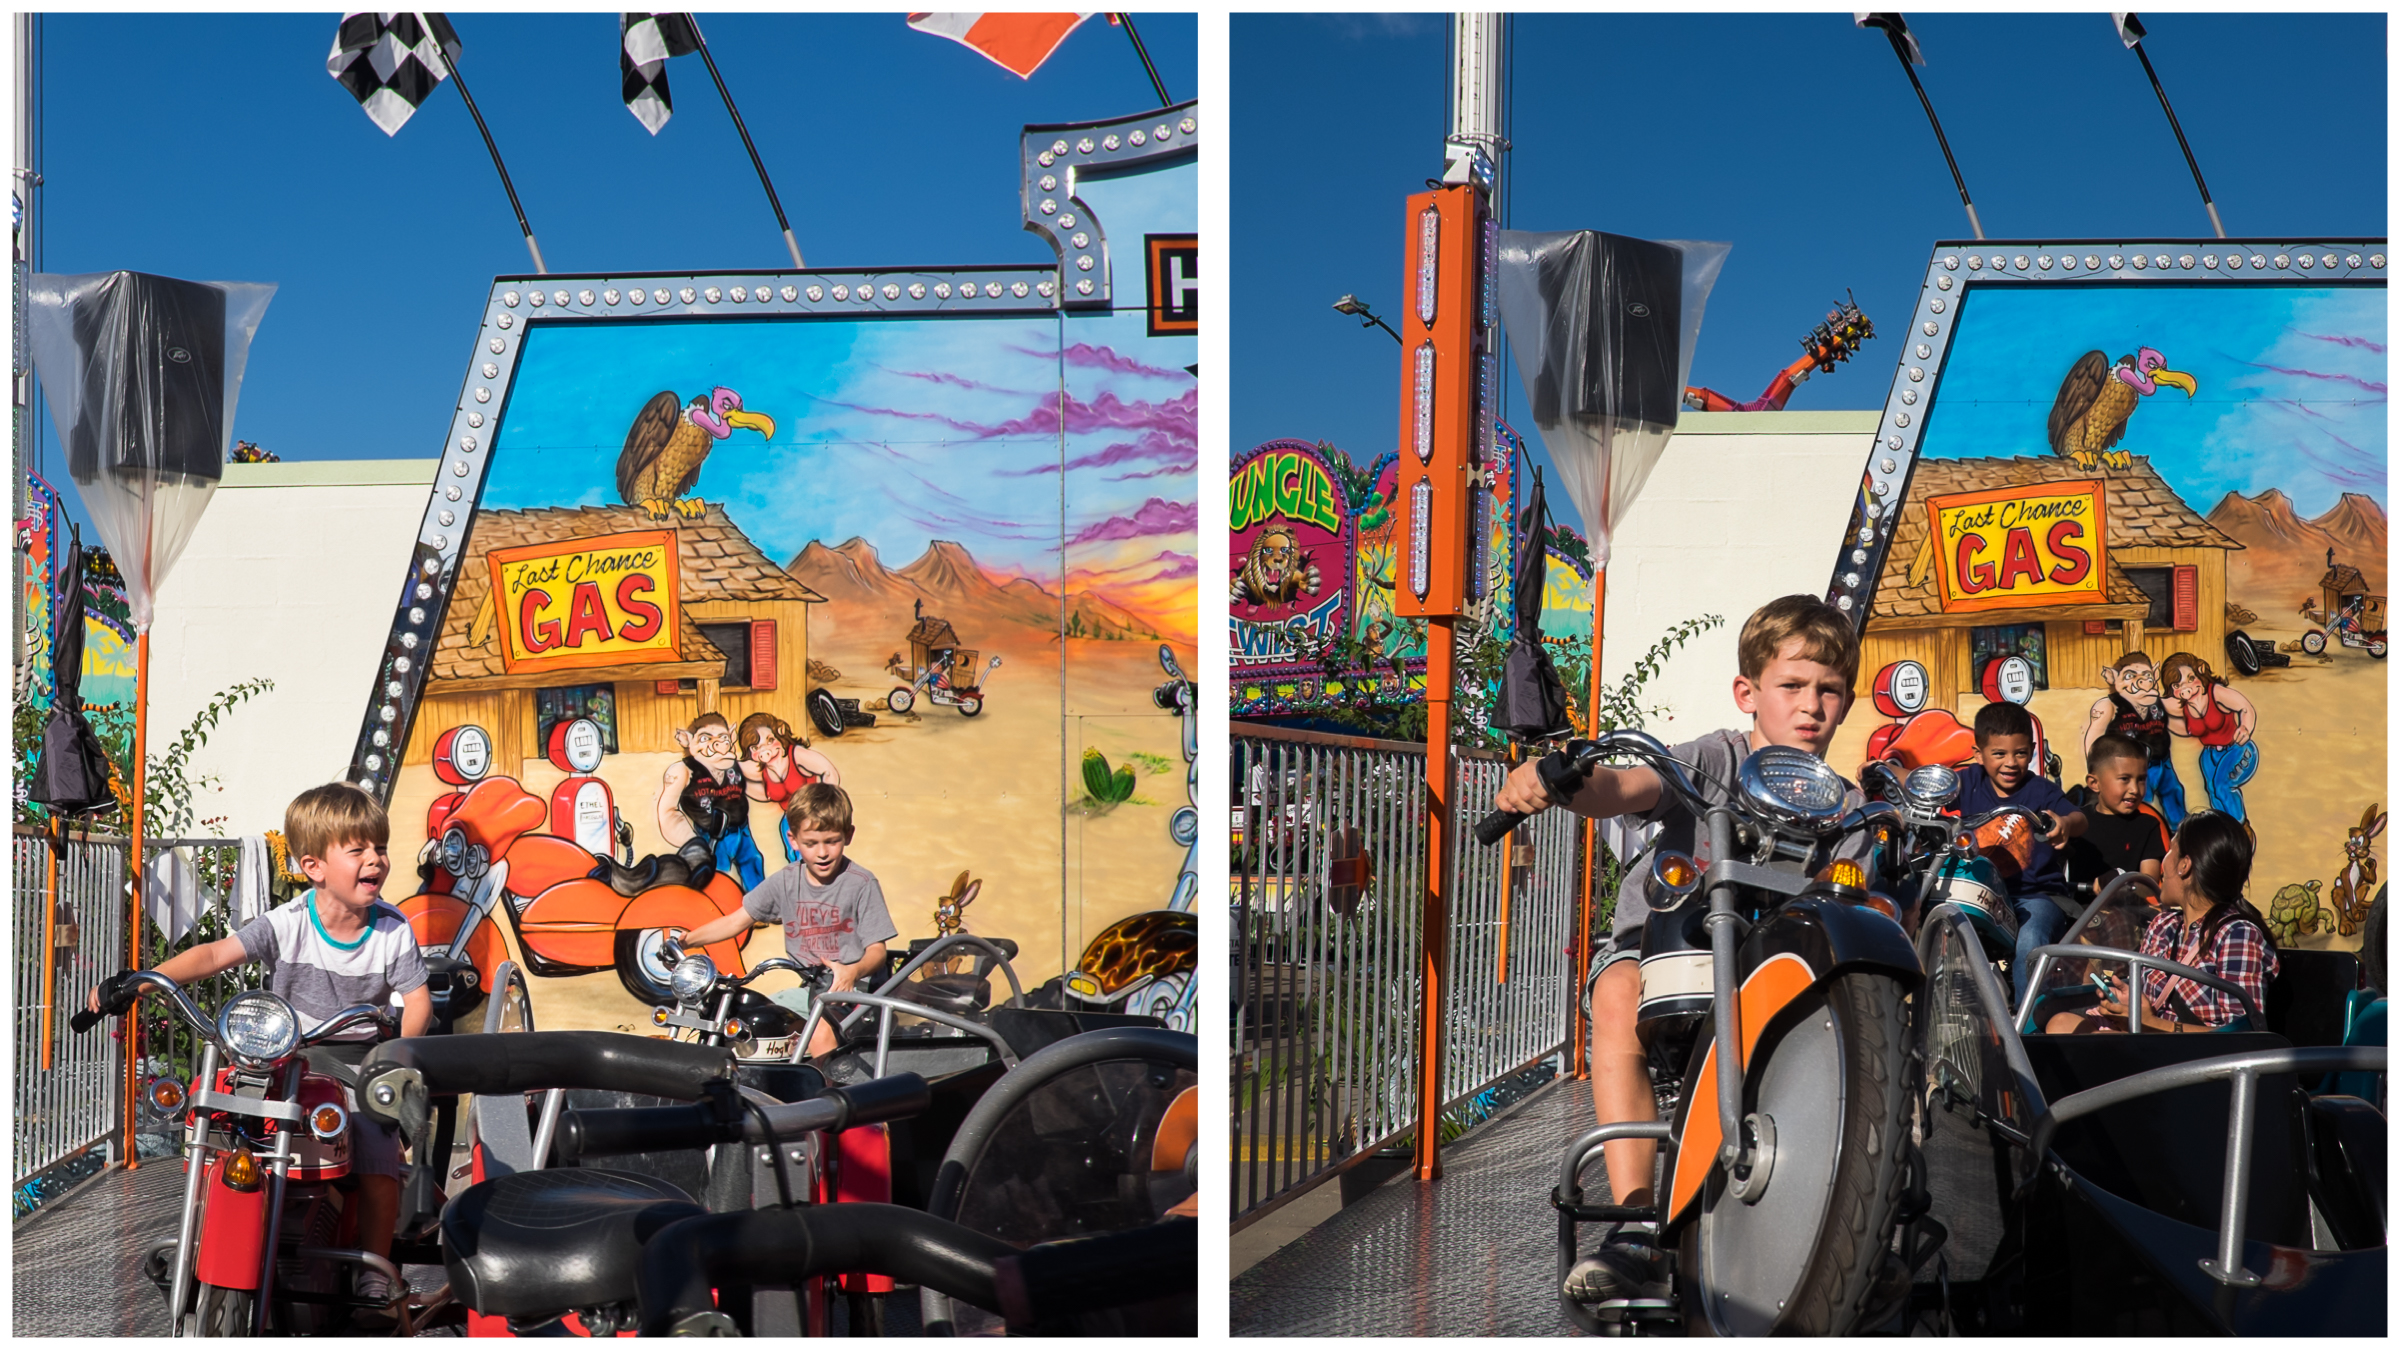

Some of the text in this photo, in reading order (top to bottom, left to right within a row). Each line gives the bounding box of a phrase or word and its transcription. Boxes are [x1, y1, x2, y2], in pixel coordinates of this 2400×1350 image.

[1950, 499, 2088, 538] Last Chance
[512, 551, 658, 594] Last Chance
[1956, 519, 2092, 595] GAS
[520, 573, 663, 654] GAS
[580, 801, 604, 810] ETHEL
